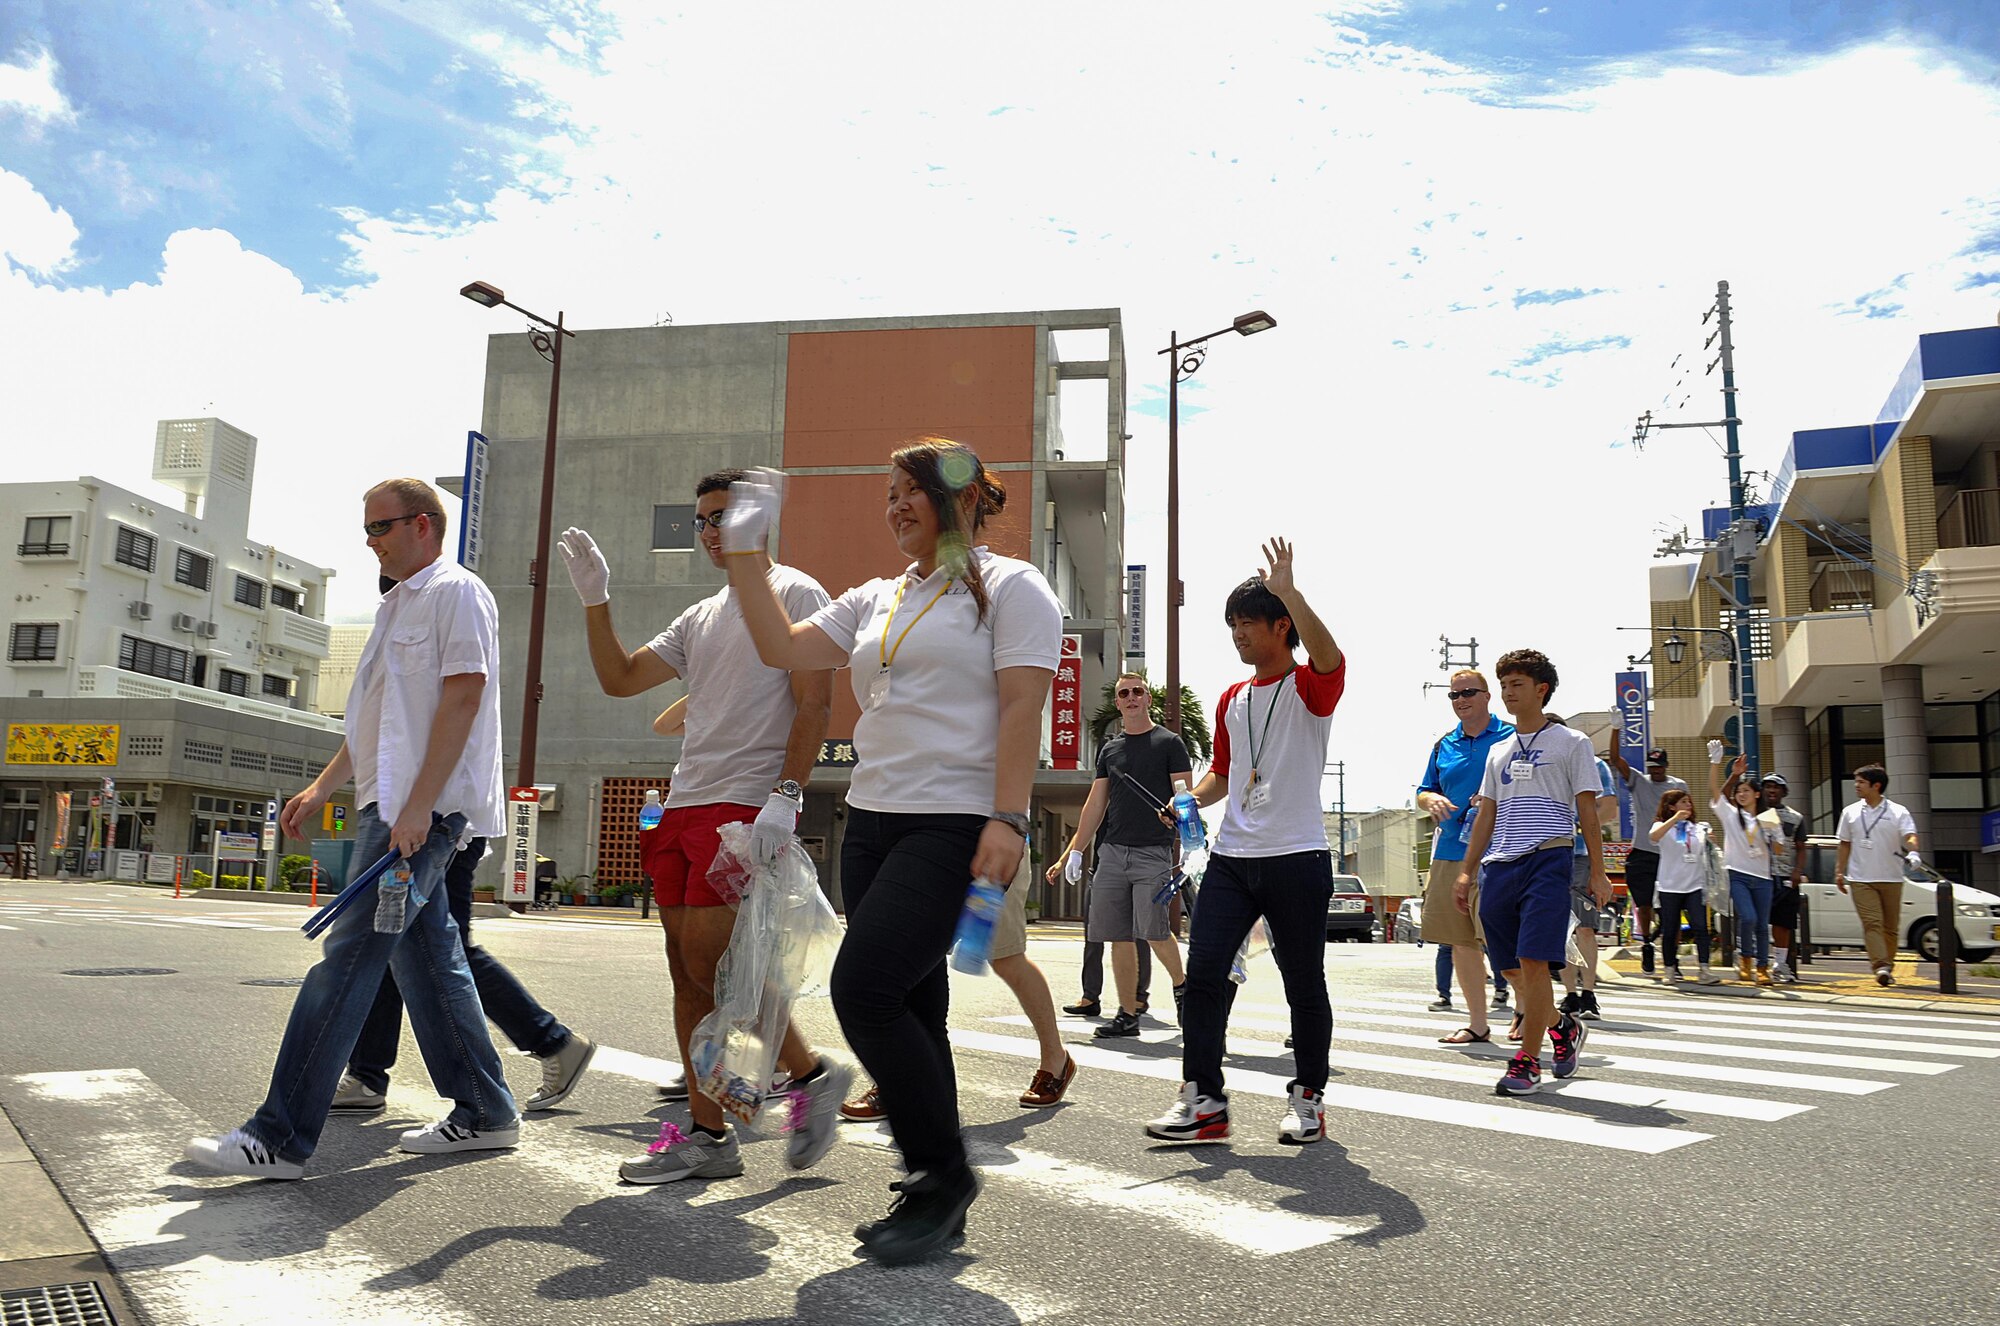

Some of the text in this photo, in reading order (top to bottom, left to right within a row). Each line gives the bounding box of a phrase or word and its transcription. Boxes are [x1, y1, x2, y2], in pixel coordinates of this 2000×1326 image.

[1056, 666, 1076, 746] 琉球銀行
[1623, 688, 1643, 747] KAIHO
[1507, 749, 1544, 769] NKE
[266, 801, 277, 821] P
[334, 806, 344, 818] P
[513, 803, 531, 895] 駐車場2時間無料
